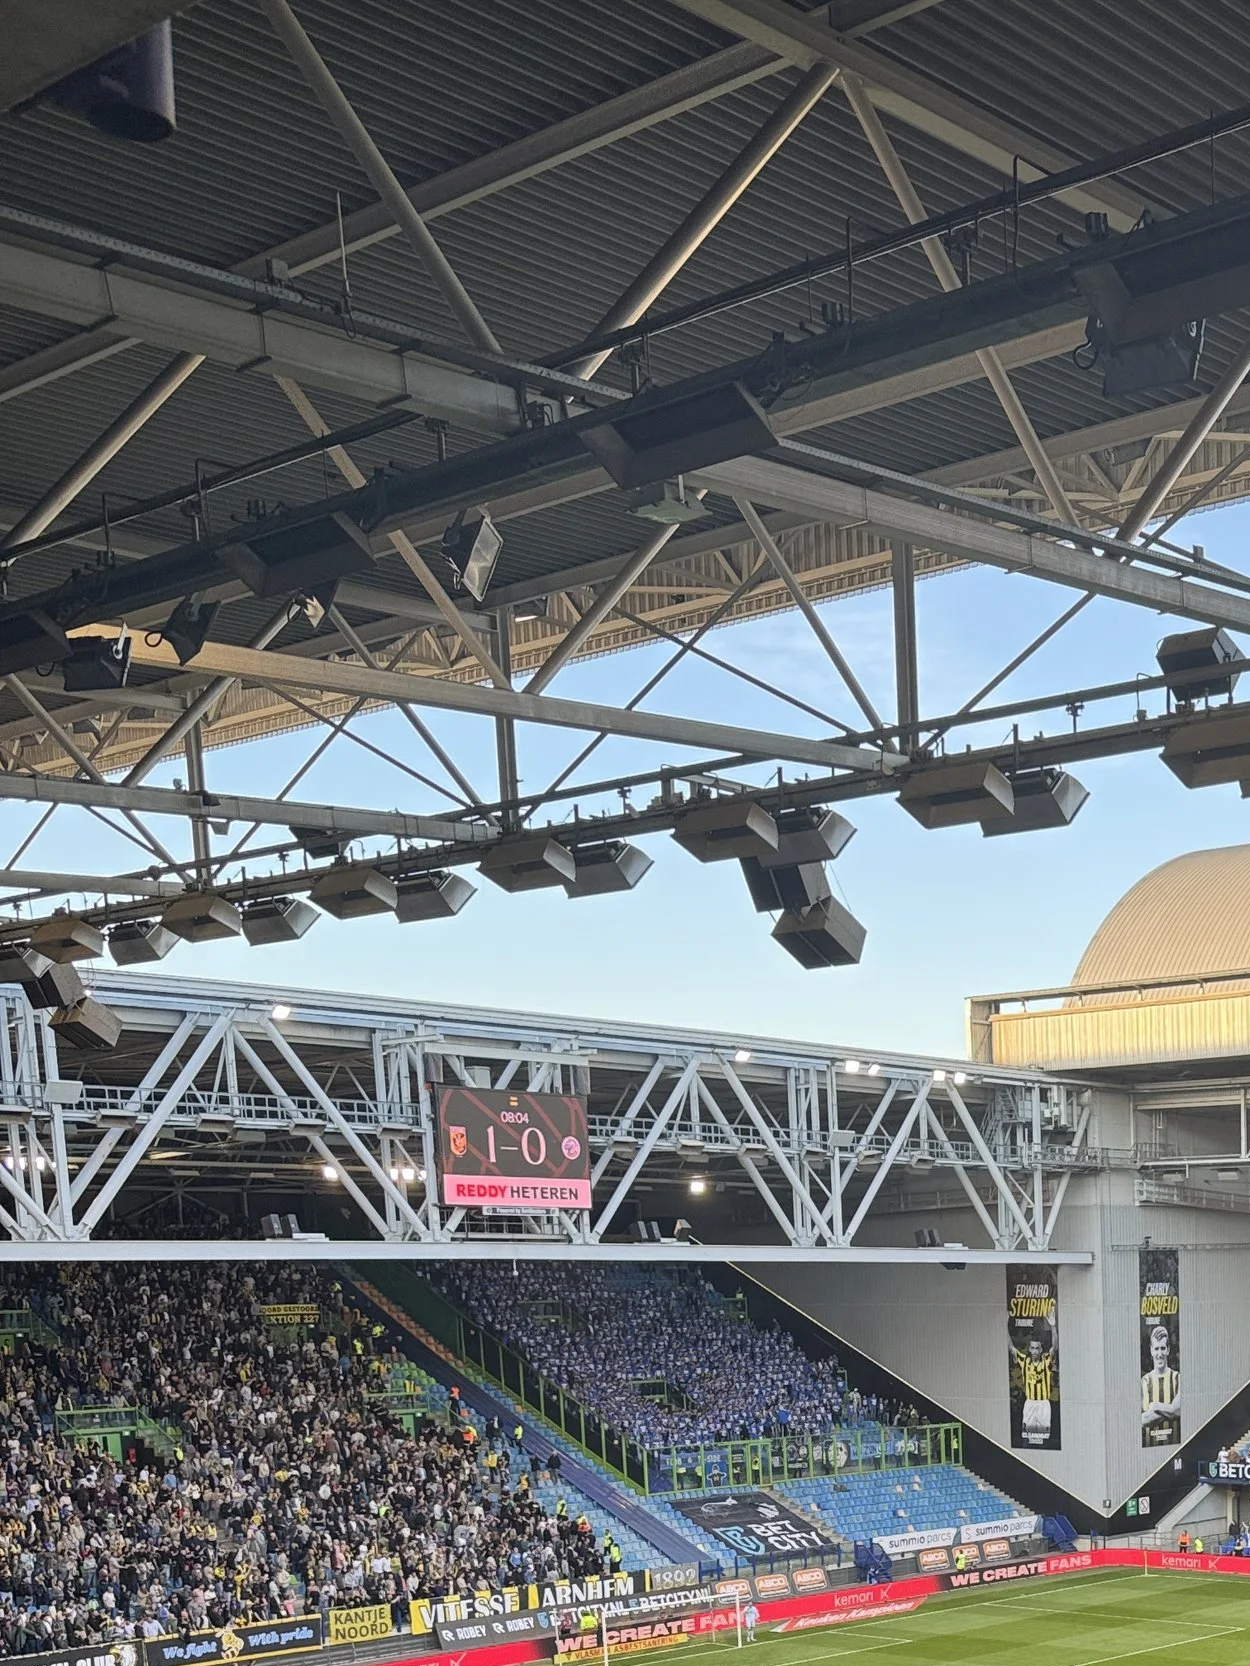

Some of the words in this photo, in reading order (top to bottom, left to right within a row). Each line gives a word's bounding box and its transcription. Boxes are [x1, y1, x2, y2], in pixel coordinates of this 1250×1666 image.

[500, 1111, 529, 1124] 08:04
[457, 1184, 507, 1198] REDDY
[511, 1187, 578, 1200] HETEREN
[1015, 1284, 1049, 1298] EDWARD
[1146, 1283, 1170, 1296] CHARLY
[1009, 1298, 1056, 1317] STURING
[1141, 1296, 1178, 1315] BOSVELD
[303, 1314, 319, 1323] 227
[747, 1520, 799, 1537] BET
[975, 1525, 1009, 1536] summio
[1010, 1520, 1033, 1533] parcs
[767, 1531, 824, 1550] CITY
[889, 1537, 925, 1548] summio
[927, 1531, 951, 1545] parcs
[986, 1542, 1008, 1553] ABCO
[922, 1551, 946, 1563] ABCO
[1161, 1554, 1201, 1568] kemari
[653, 1568, 696, 1590] 1892
[950, 1572, 980, 1587] WE
[982, 1561, 1048, 1582] CREATE
[1049, 1554, 1092, 1570] FANS
[834, 1591, 874, 1607] kemari
[334, 1607, 386, 1626] KANTJE
[419, 1593, 519, 1628] VITESSE
[335, 1621, 389, 1640] NOORD
[456, 1625, 487, 1640] ROBEY
[506, 1617, 535, 1633] ROBEY
[556, 1634, 597, 1653] WE
[606, 1619, 696, 1645] CREATE
[163, 1646, 184, 1660] We
[183, 1641, 217, 1660] fight
[248, 1631, 280, 1647] With
[280, 1626, 314, 1644] pride
